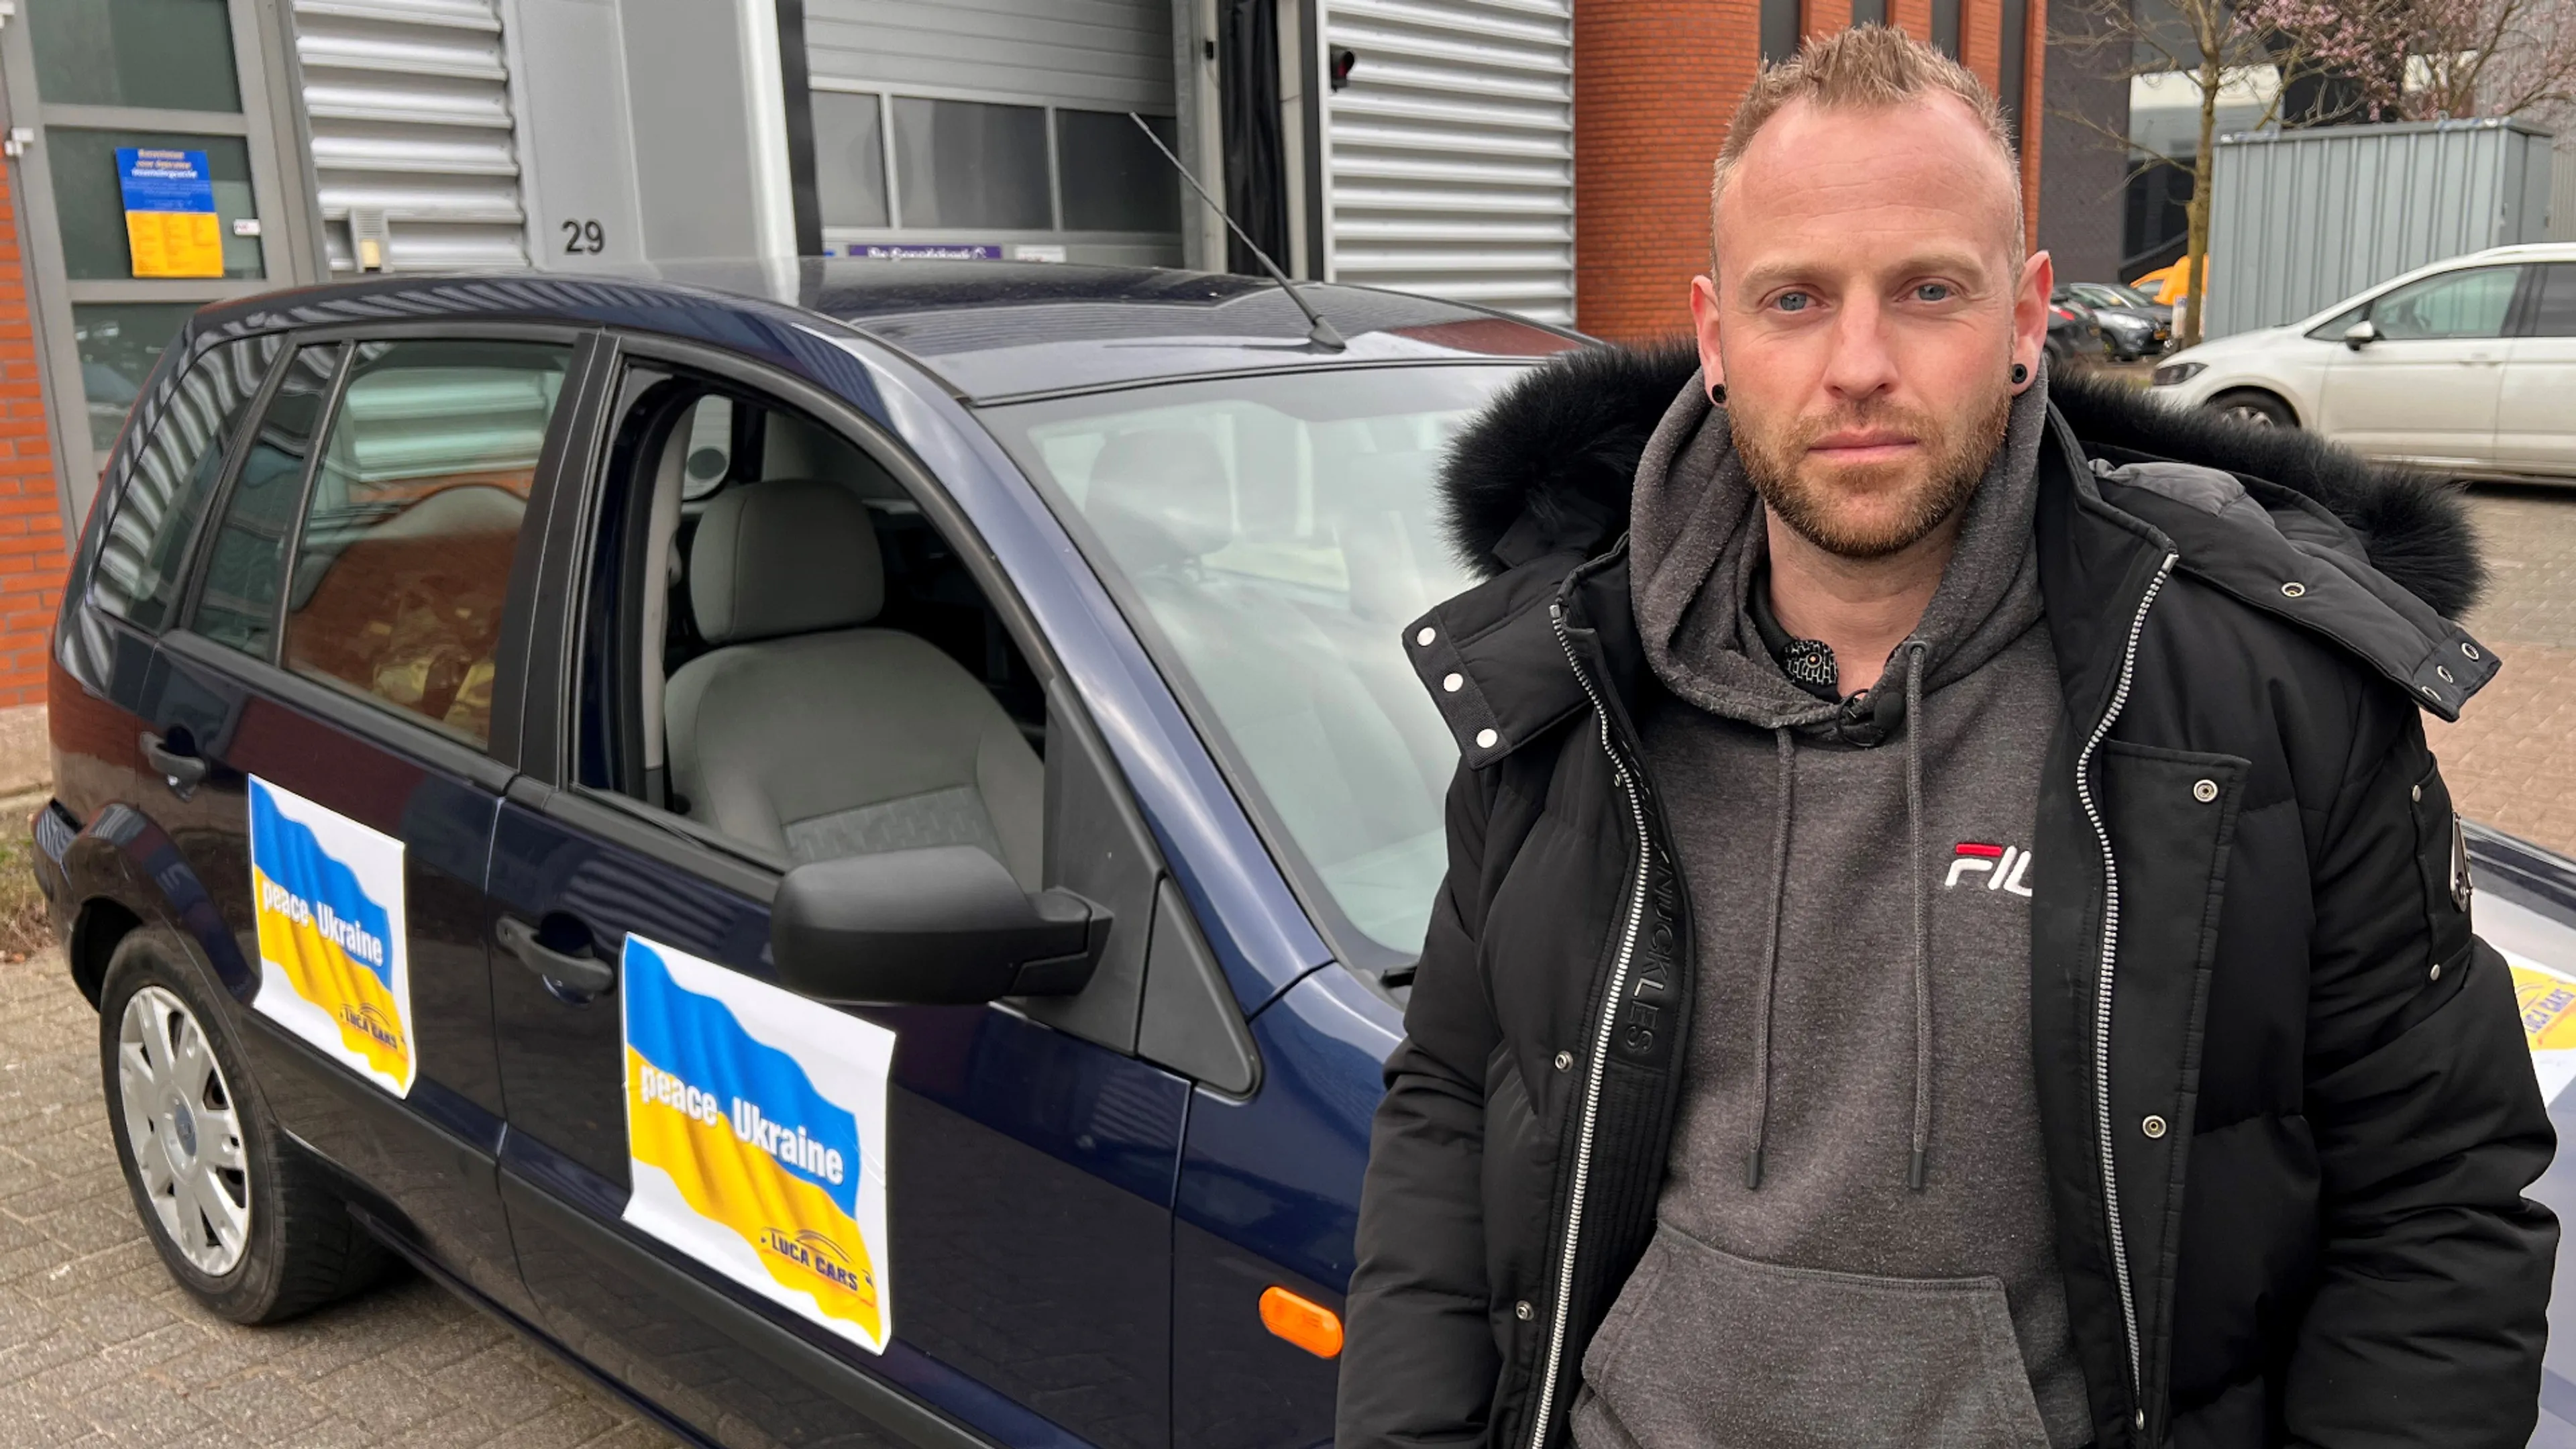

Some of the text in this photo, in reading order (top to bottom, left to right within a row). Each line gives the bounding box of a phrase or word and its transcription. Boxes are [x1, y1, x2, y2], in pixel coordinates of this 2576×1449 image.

[561, 219, 606, 255] 29
[262, 880, 384, 967] peace Ukraine
[345, 1006, 398, 1051] LUCA CARS
[641, 1065, 844, 1187] peace Ukraine
[771, 1232, 858, 1292] LUCA CARS
